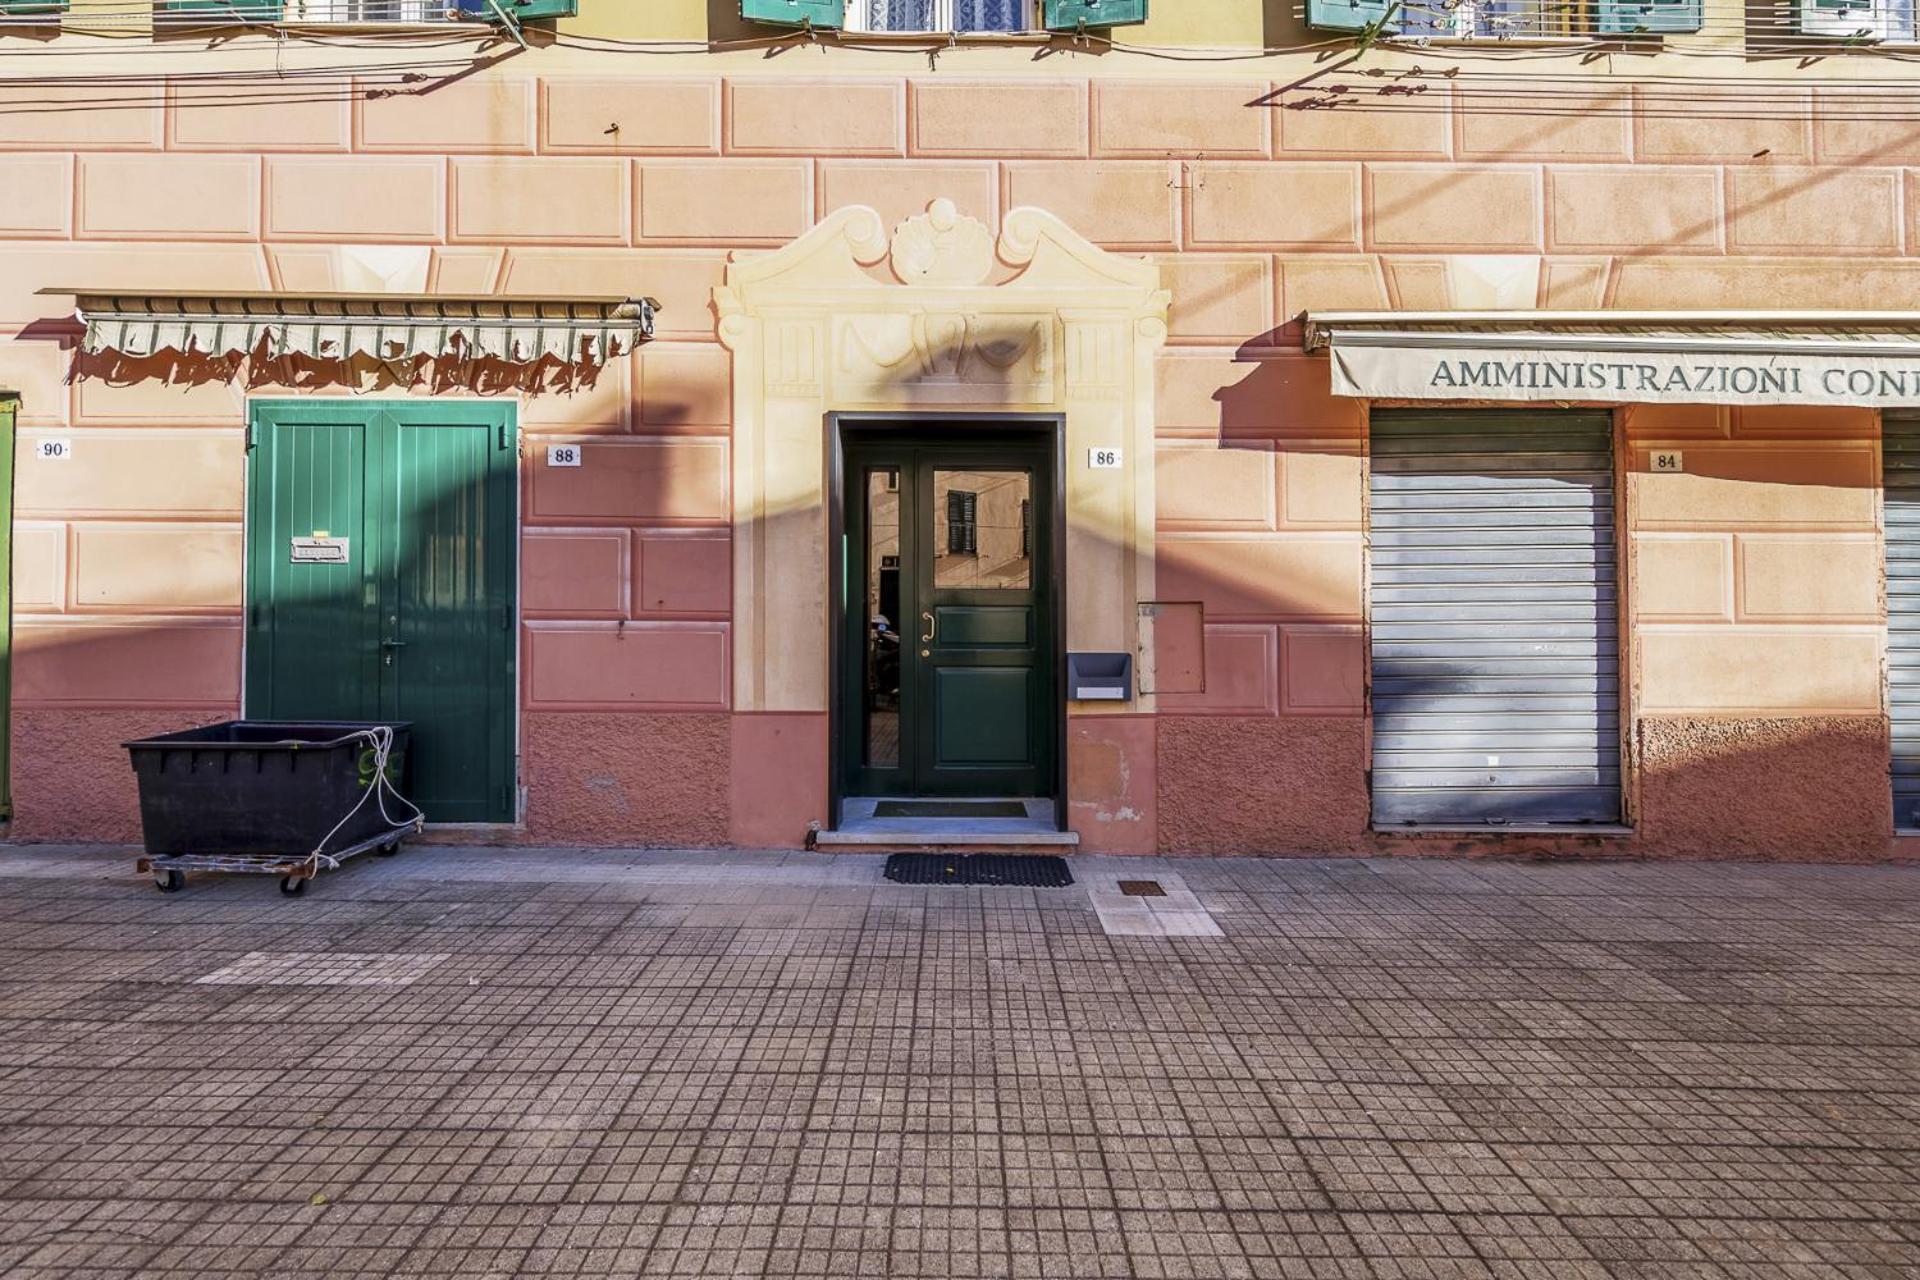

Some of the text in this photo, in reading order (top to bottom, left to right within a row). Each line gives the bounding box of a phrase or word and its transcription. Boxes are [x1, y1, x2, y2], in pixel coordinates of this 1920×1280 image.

[1430, 360, 1802, 394] AMMINISTRAZIONI
[44, 442, 63, 456] 90
[555, 449, 574, 463] 88
[1096, 451, 1115, 465] 86
[1658, 454, 1676, 468] 84
